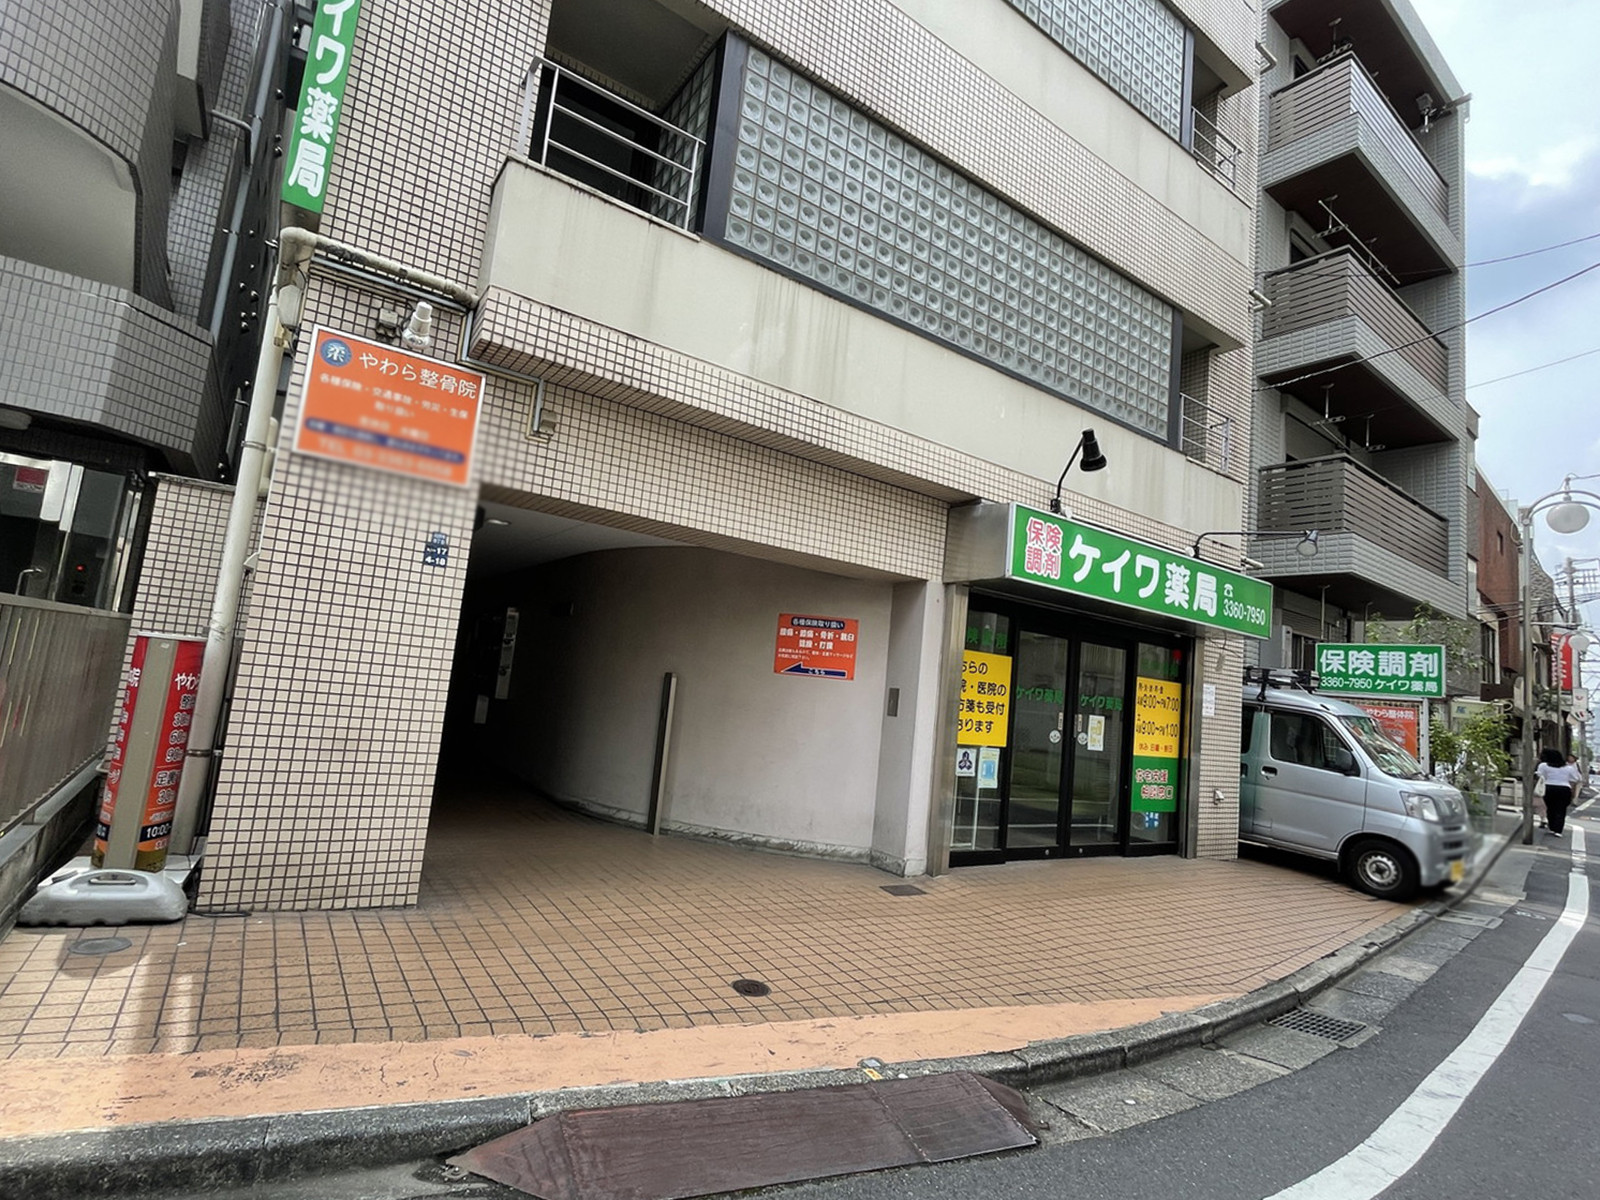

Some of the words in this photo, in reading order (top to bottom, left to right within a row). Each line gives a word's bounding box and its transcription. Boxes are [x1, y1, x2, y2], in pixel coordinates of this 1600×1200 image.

[359, 352, 477, 399] やわら整骨院
[1026, 516, 1063, 553] 保険
[1024, 544, 1063, 580] 調剤
[1069, 533, 1218, 618] ケイワ薬局
[1222, 598, 1266, 626] 3360-7950
[1320, 649, 1439, 678] 保険調剤
[1320, 676, 1373, 689] 3360-7950
[1374, 679, 1438, 693] ケイワ薬局
